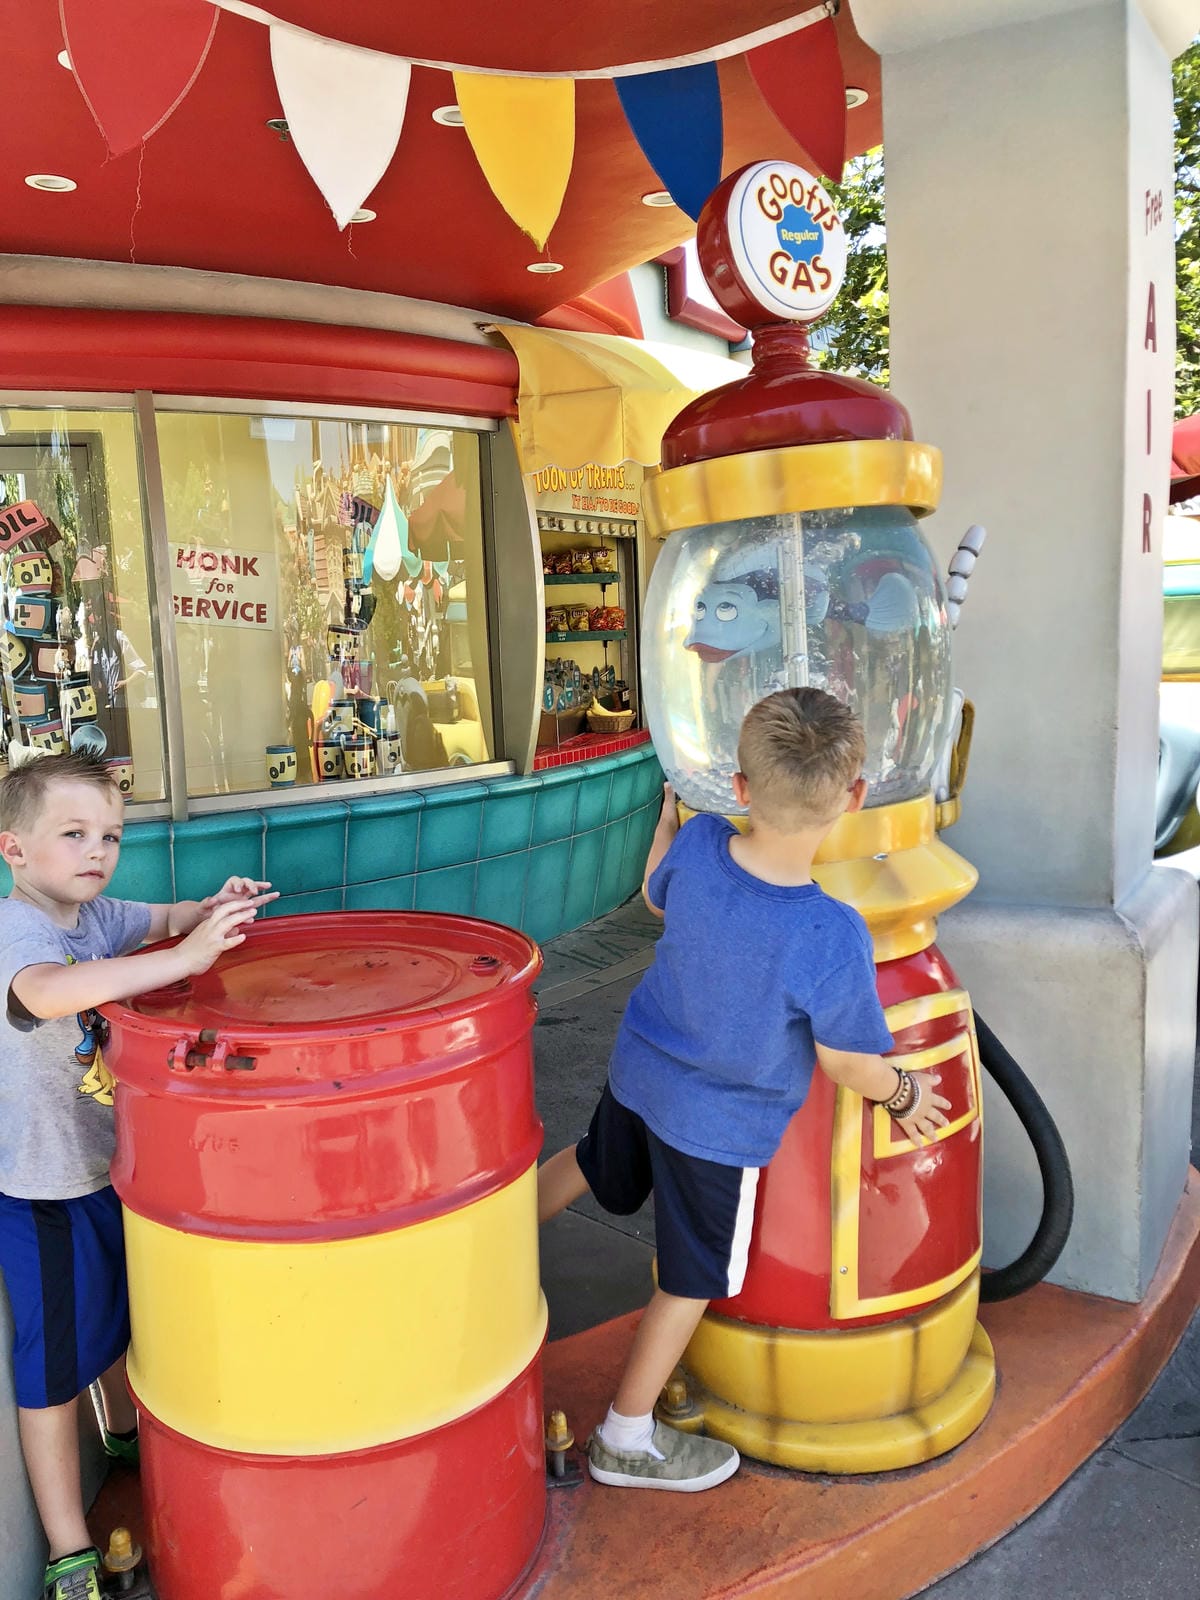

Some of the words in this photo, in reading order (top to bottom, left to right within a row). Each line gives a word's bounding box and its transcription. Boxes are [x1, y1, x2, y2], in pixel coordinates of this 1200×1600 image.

[1145, 189, 1163, 236] Free
[781, 229, 819, 244] Regular
[769, 251, 832, 293] GAS
[533, 466, 567, 494] TOON
[570, 468, 584, 489] UP
[20, 558, 49, 584] OIL
[176, 548, 260, 577] HONK
[269, 755, 296, 780] OIL
